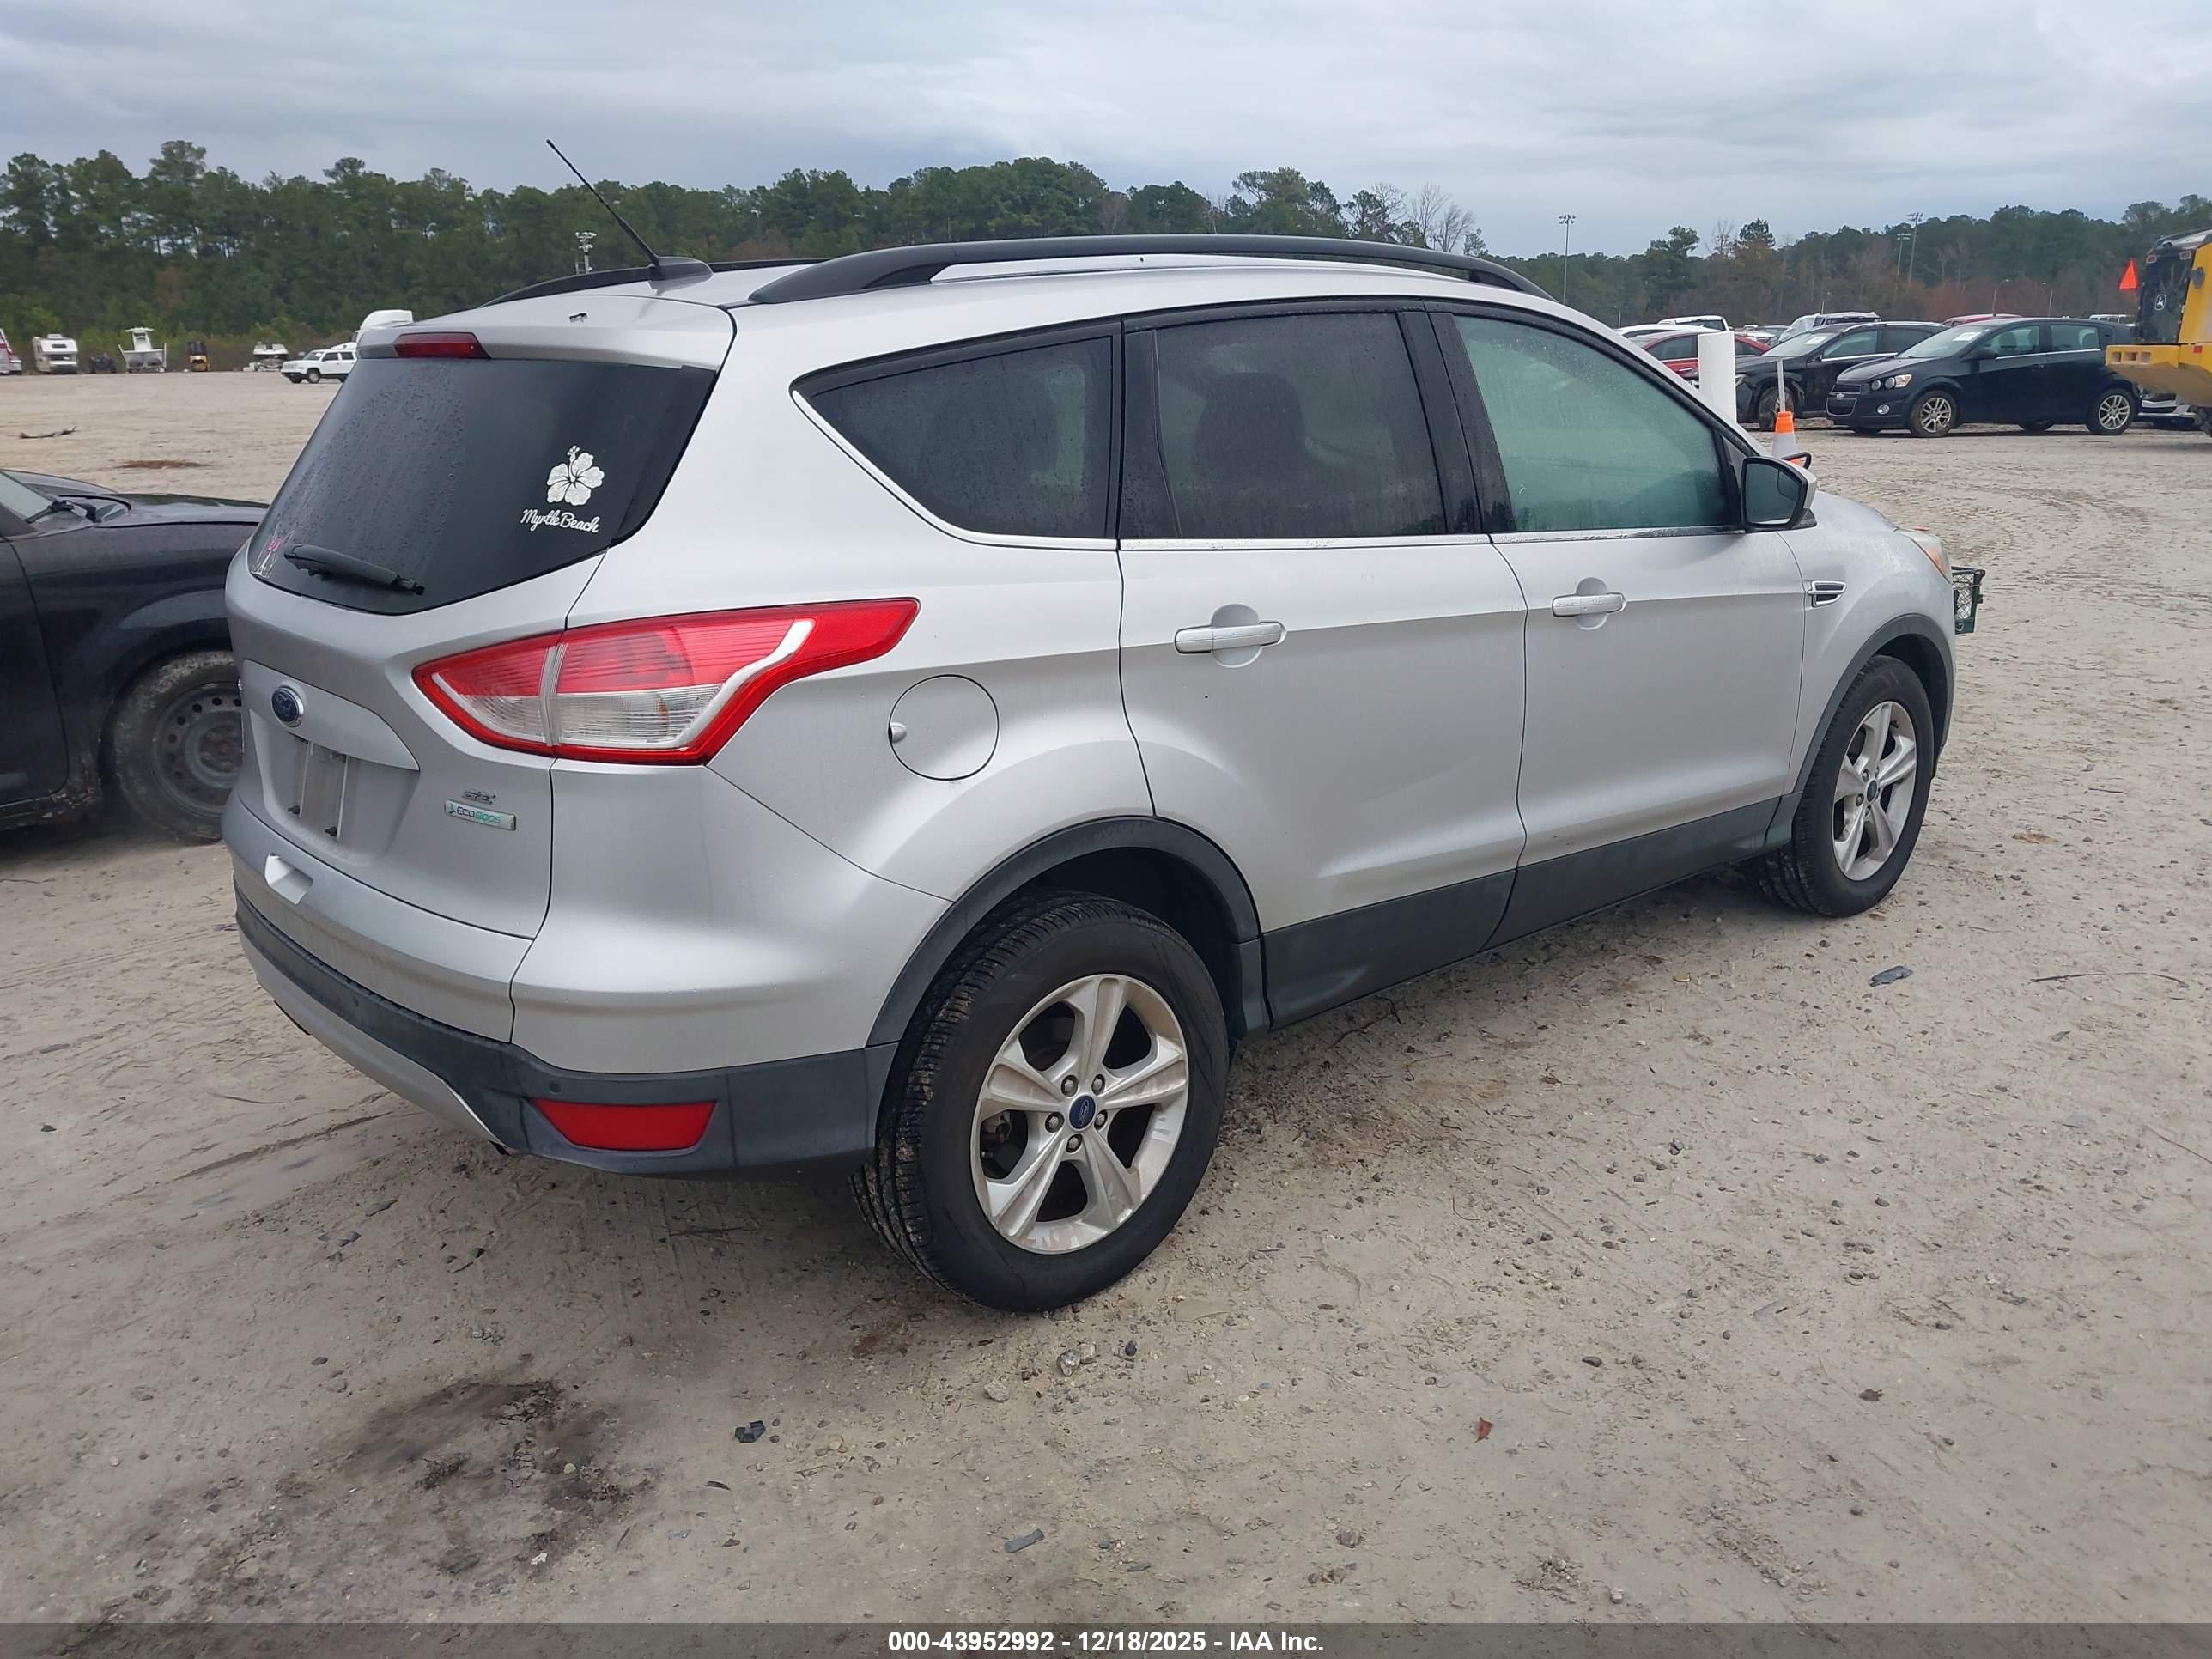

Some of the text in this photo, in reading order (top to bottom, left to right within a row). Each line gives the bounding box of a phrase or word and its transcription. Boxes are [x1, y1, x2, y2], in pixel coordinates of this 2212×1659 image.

[520, 508, 600, 533] Myrtle Beach
[456, 805, 503, 824] ECOBOOS
